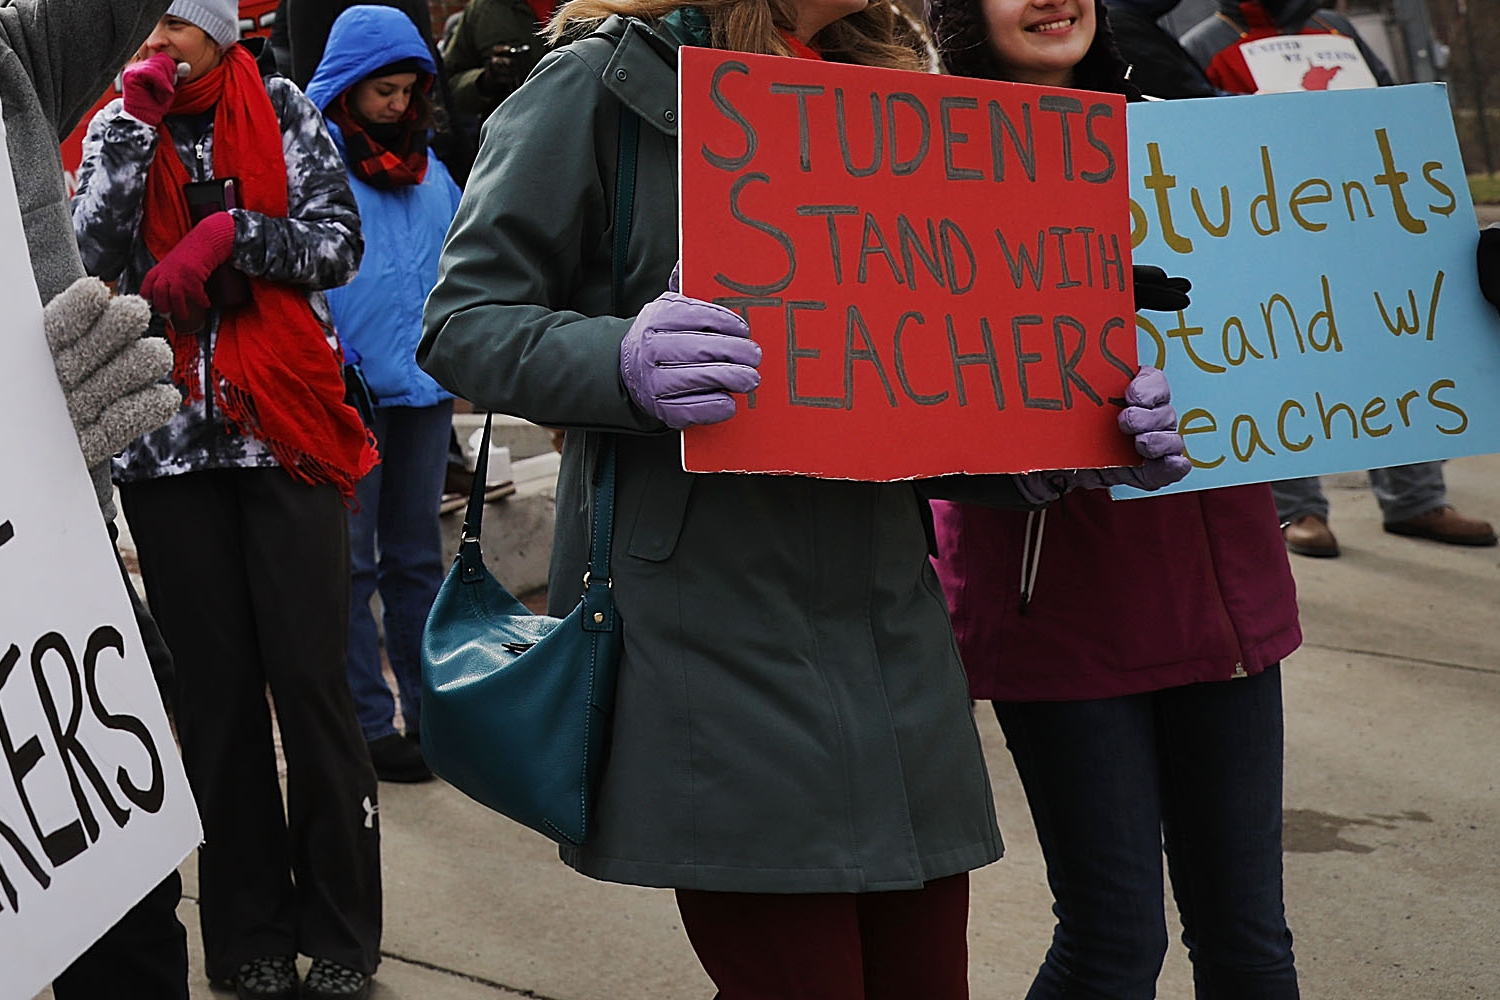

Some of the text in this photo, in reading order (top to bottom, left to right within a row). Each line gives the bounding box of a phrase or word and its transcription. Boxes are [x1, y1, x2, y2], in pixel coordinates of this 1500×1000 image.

[701, 60, 1117, 184] STUDENTS
[714, 171, 1126, 297] STAND WITH
[1373, 270, 1445, 342] w/
[1177, 378, 1469, 469] eachers
